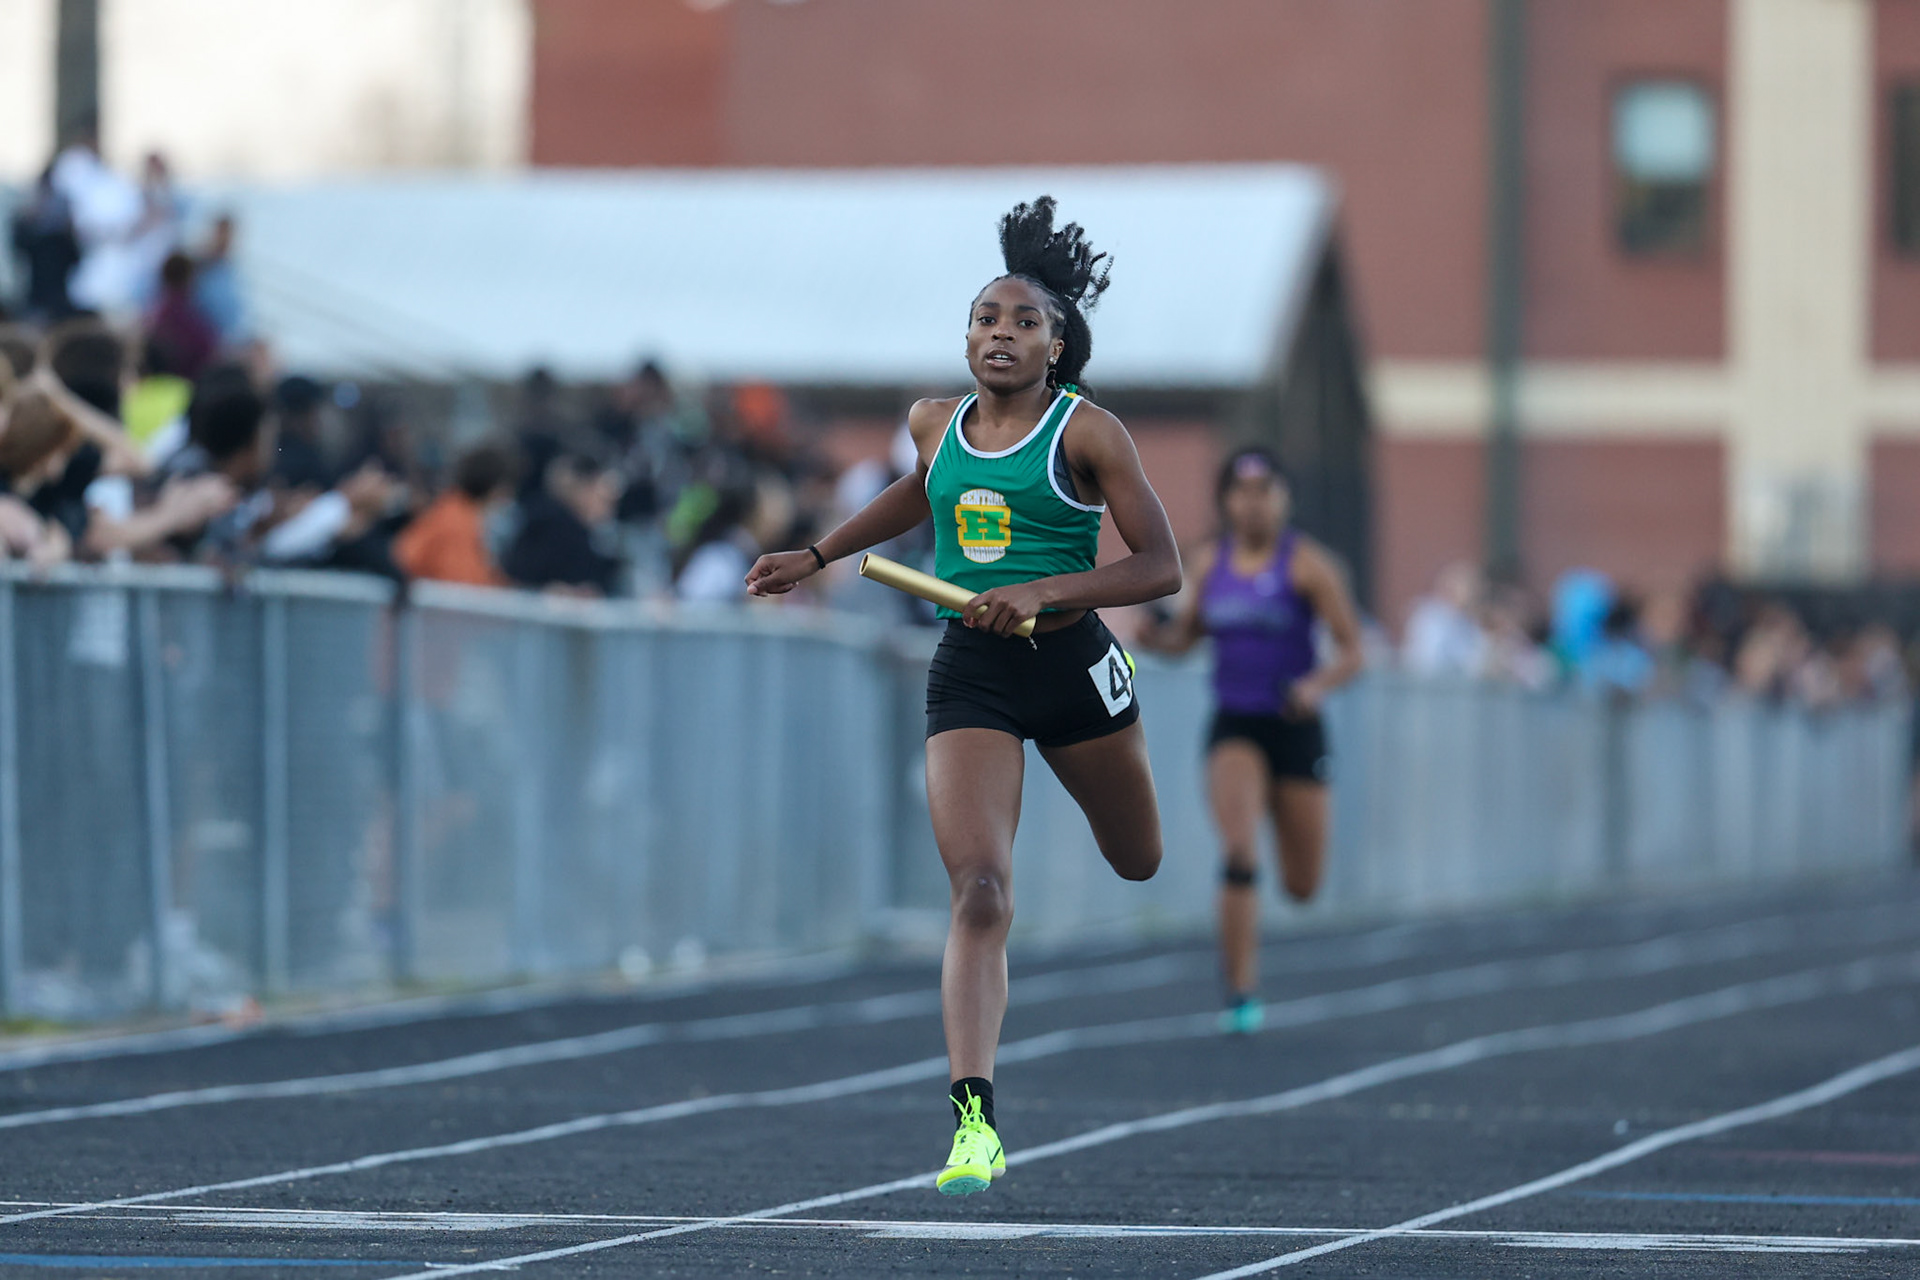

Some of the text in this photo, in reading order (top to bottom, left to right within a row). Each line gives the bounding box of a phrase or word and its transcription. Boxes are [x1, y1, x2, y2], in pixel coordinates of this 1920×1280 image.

[960, 488, 1006, 506] CENTRAL
[957, 507, 1009, 544] H
[1108, 654, 1131, 702] 4
